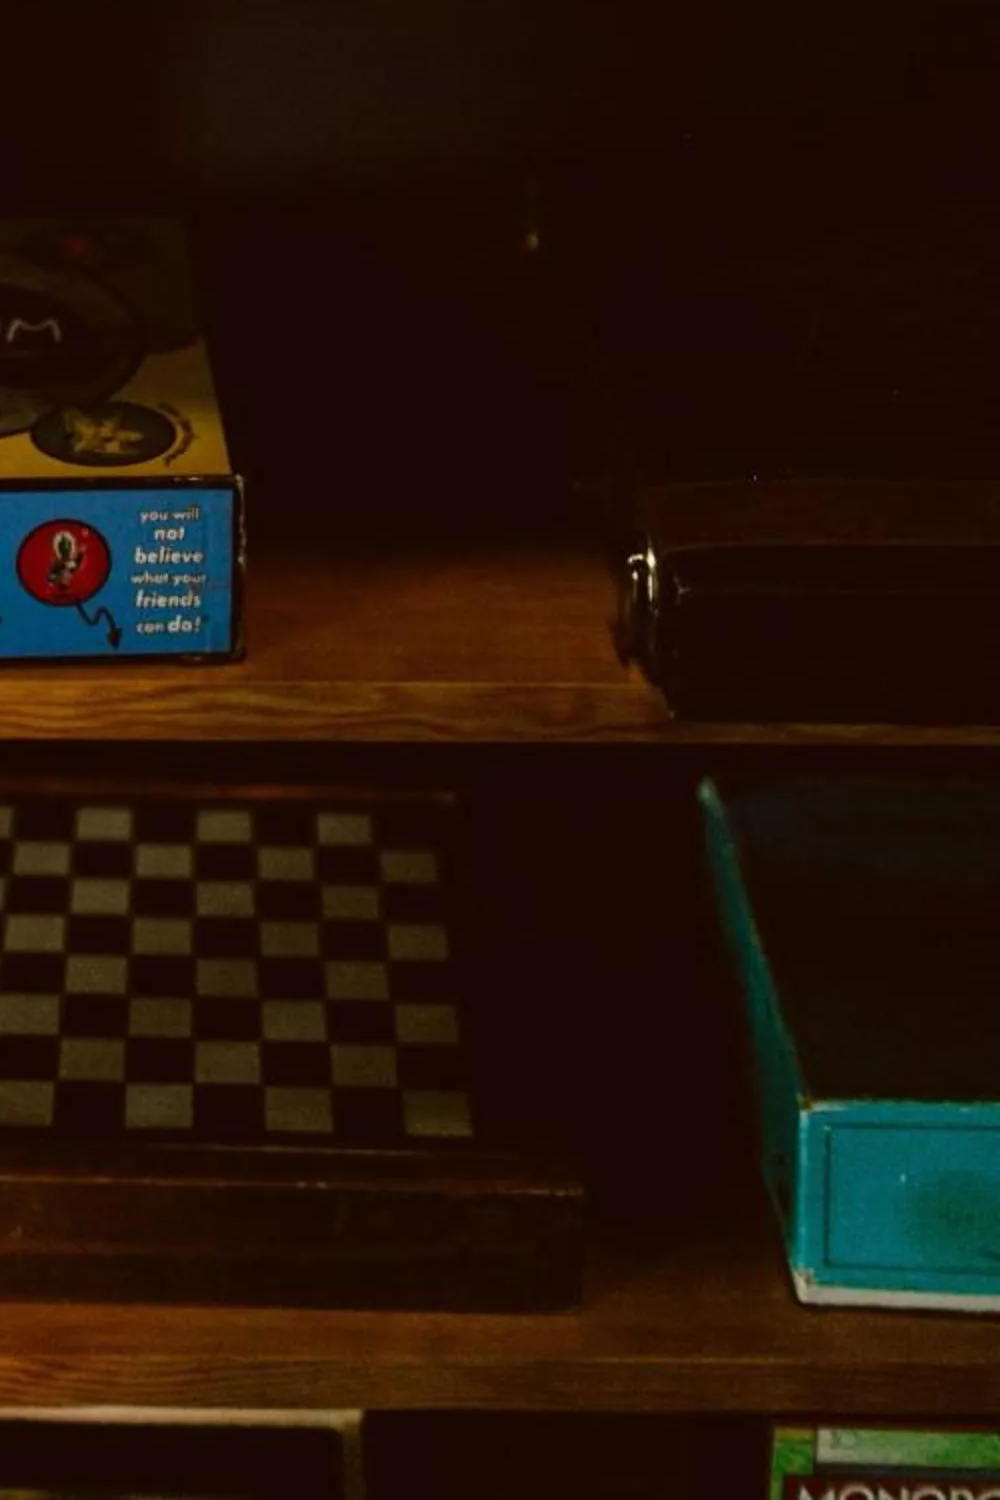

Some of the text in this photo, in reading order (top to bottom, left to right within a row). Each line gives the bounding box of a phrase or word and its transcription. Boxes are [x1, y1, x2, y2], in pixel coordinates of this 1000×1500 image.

[140, 506, 200, 523] you will
[153, 525, 186, 541] not
[134, 547, 204, 565] believe
[130, 572, 207, 587] what your
[135, 589, 202, 609] friends
[136, 614, 202, 635] can do!
